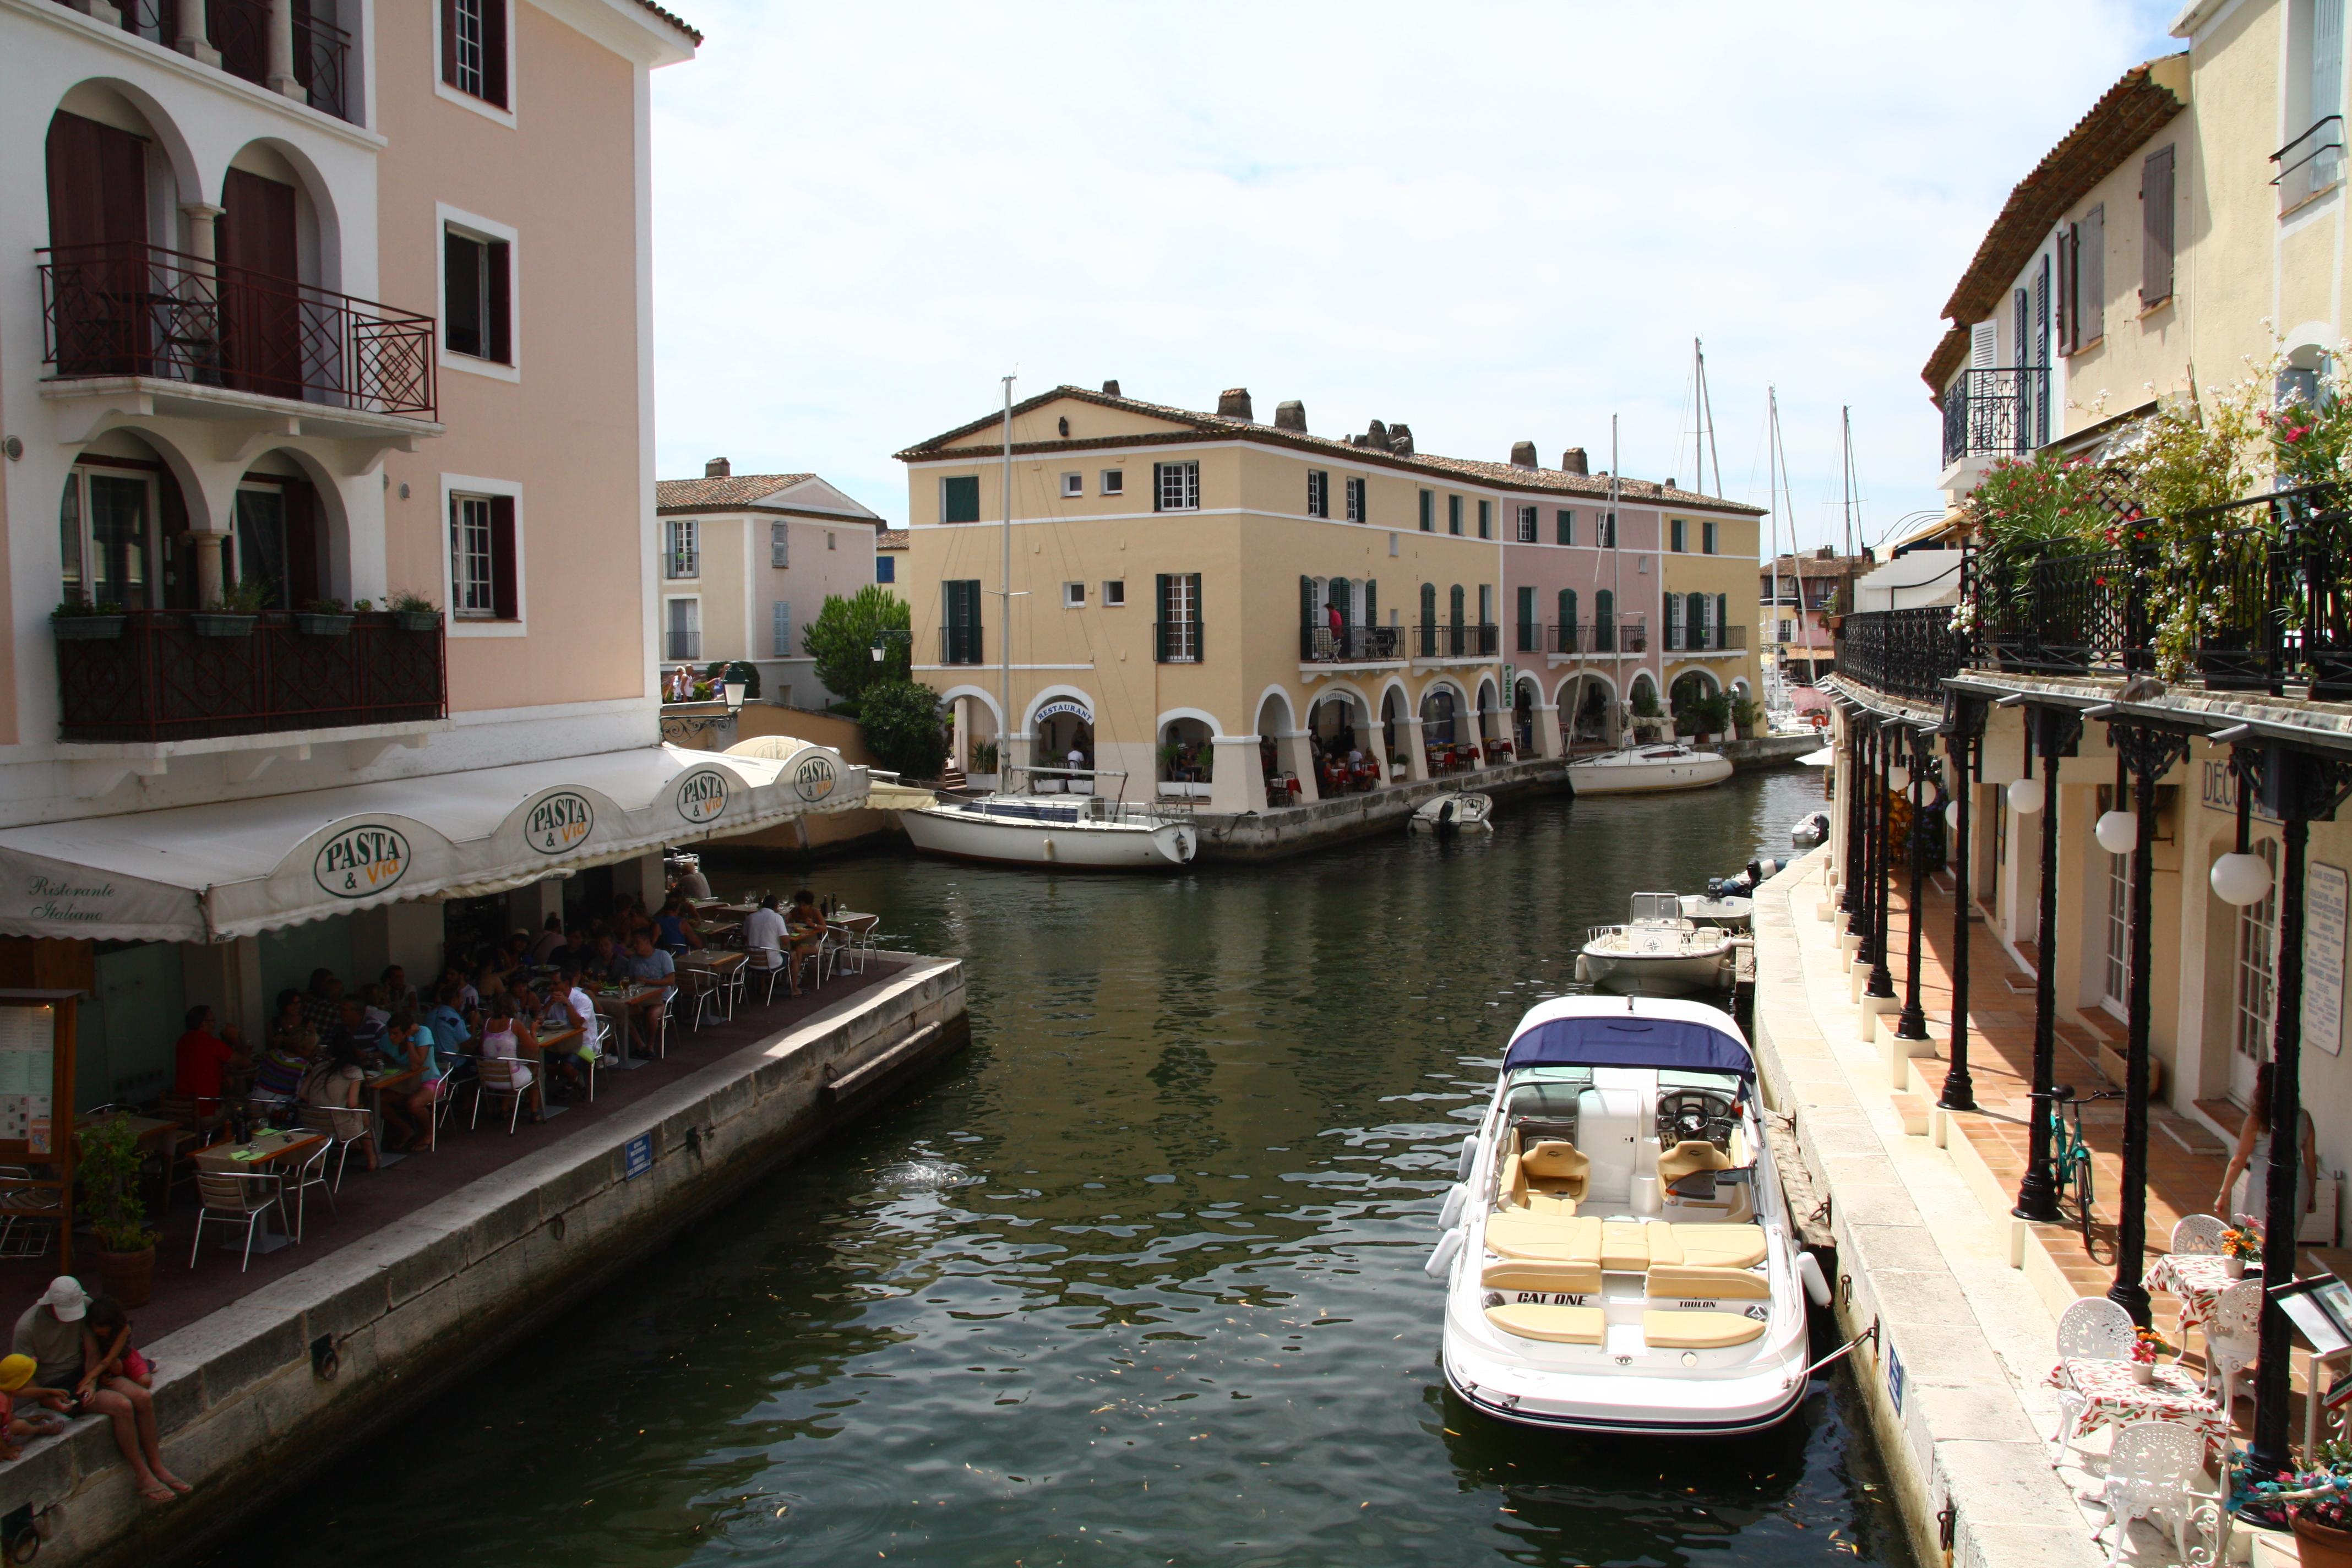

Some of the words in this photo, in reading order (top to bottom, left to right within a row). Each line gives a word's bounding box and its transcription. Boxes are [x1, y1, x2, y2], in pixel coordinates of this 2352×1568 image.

[1037, 704, 1092, 721] RESTAURANT
[799, 761, 832, 784] PASTA
[684, 776, 723, 804] PASTA
[807, 785, 813, 796] &
[817, 781, 831, 794] Via
[533, 798, 587, 832] PASTA
[694, 804, 700, 816] &
[705, 797, 722, 814] Via
[546, 832, 555, 847] &
[562, 821, 585, 842] Via
[326, 832, 402, 872] PASTA
[345, 872, 357, 889] &
[367, 858, 399, 885] Via
[29, 875, 115, 897] Ristorante
[31, 900, 103, 921] Italiano
[1517, 1292, 1549, 1304] CAT
[1554, 1294, 1588, 1305] ONE
